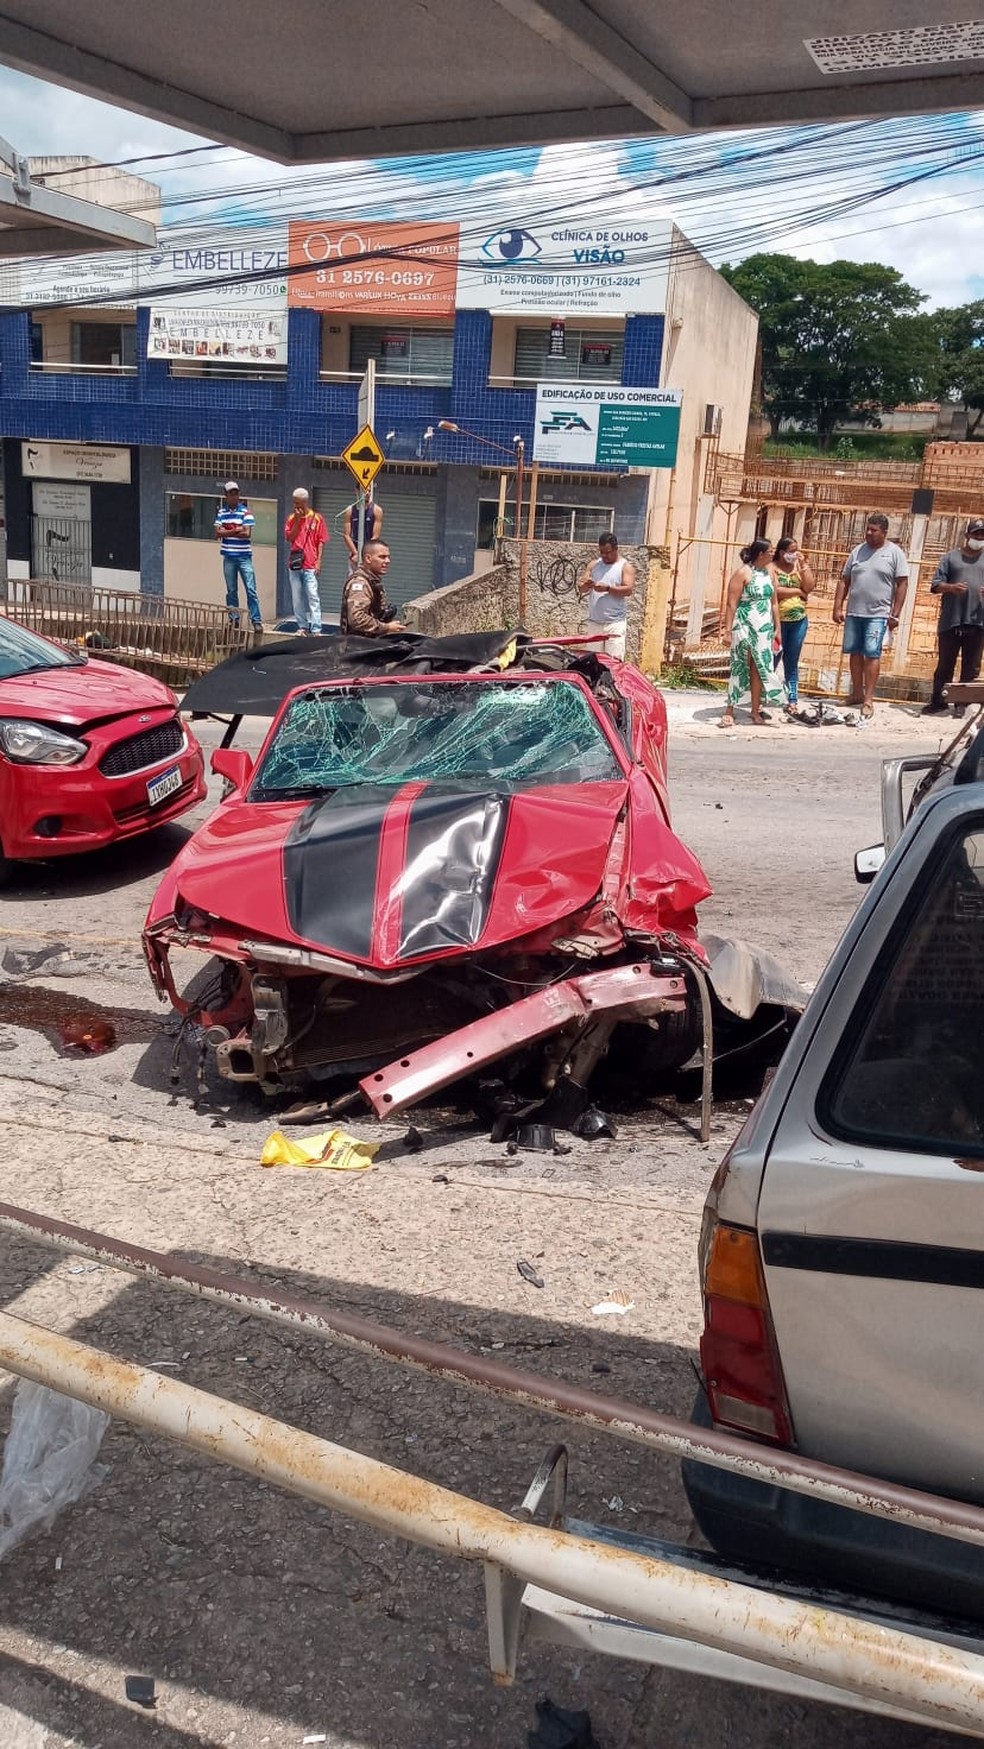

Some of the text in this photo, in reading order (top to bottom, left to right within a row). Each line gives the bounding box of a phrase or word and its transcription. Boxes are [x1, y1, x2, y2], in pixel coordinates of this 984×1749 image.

[810, 30, 915, 44] JUIZADO
[811, 38, 893, 49] DIREITO
[551, 230, 649, 242] CLÍNICA DE OLHOS
[173, 251, 288, 271] EMBELLEZE
[573, 246, 625, 264] VISÃO
[342, 271, 435, 287] 2576-0697
[542, 389, 677, 403] EDIFICAÇÃO DE USO COMERCIAL
